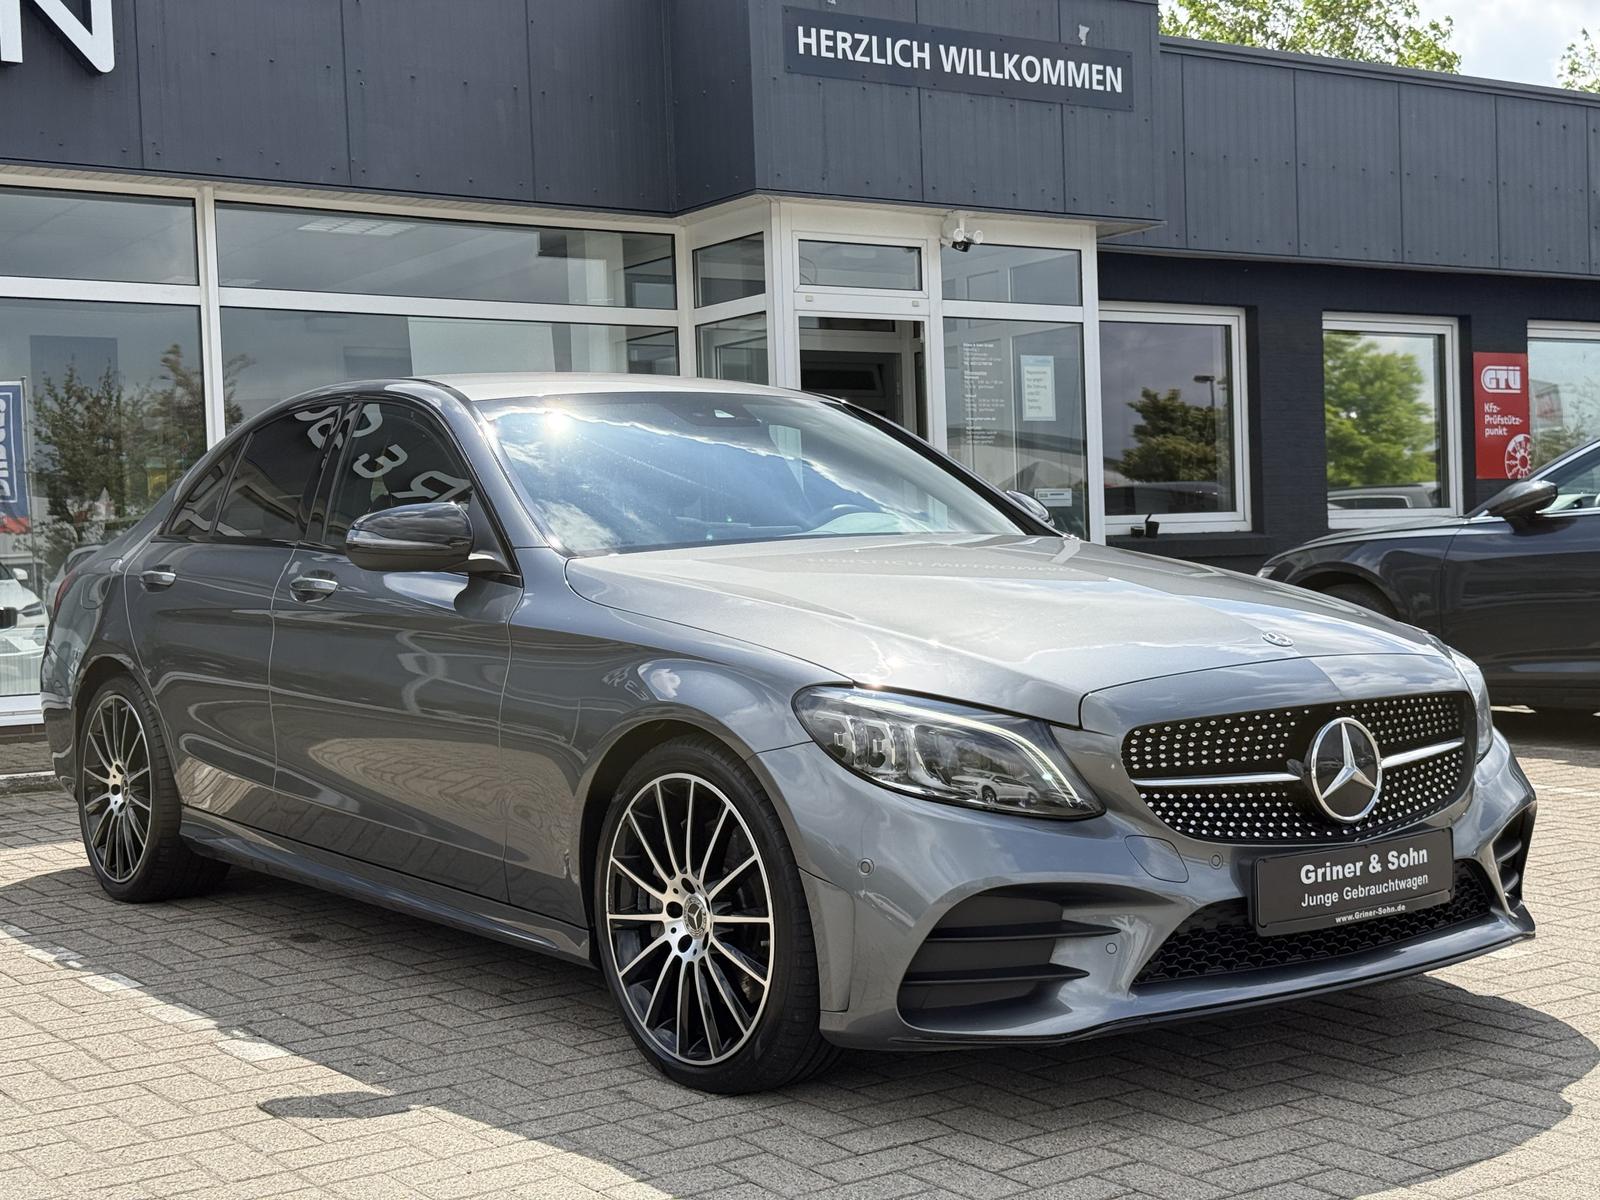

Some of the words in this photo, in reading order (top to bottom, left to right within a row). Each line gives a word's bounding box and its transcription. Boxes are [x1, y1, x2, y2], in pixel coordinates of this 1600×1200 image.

[797, 25, 931, 70] HERZLICH
[938, 44, 1123, 93] WILLKOMMEN
[1482, 366, 1521, 392] GTÜ
[1484, 402, 1500, 413] Kfz-
[1484, 414, 1523, 425] Prüfstütz-
[1485, 426, 1508, 438] punkt
[1300, 861, 1363, 884] Griner
[1368, 853, 1382, 873] &
[1387, 847, 1428, 871] Sohn
[1301, 893, 1339, 907] Junge
[1343, 874, 1429, 900] Gebrauchtwagen
[1335, 903, 1406, 923] www.Griner-Sohn.de
